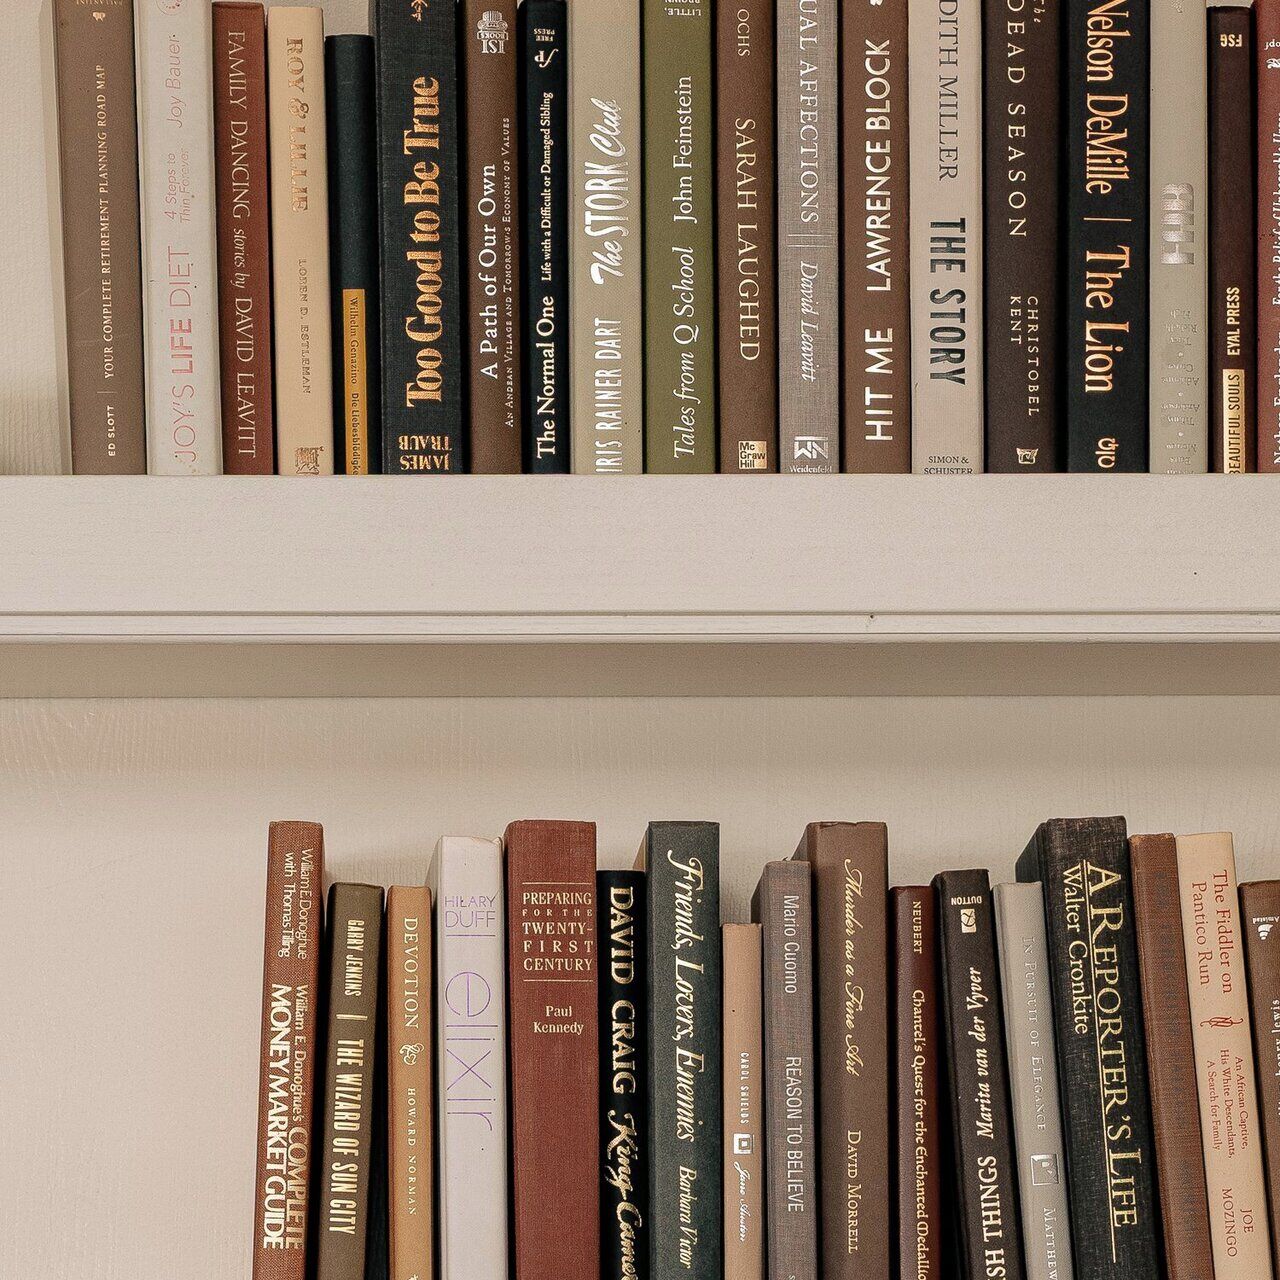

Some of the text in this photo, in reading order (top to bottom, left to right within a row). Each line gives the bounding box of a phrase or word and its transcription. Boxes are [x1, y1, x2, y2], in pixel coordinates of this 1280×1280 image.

[403, 75, 441, 407] Too Good to Be True
[735, 118, 761, 360] SARAH LAUGHED
[865, 40, 893, 442] HIT ME LAWRENCE BLOCK
[1085, 0, 1130, 393] Nelson DeMille The Lion
[535, 296, 555, 459] The Normal One
[930, 217, 966, 386] THE STORY
[108, 405, 116, 456] ED SLOTT
[522, 891, 592, 906] PREPARING
[523, 921, 593, 936] TWENTY-
[523, 939, 593, 954] FIRST
[523, 957, 593, 972] CENTURY
[534, 1020, 584, 1035] Kennedy
[545, 1006, 572, 1019] Paul
[611, 886, 635, 1095] DAVID CRAIG
[1087, 863, 1122, 895] A
[1108, 1147, 1142, 1228] LIFE
[263, 982, 293, 1249] MONEY MARKET GUIDE
